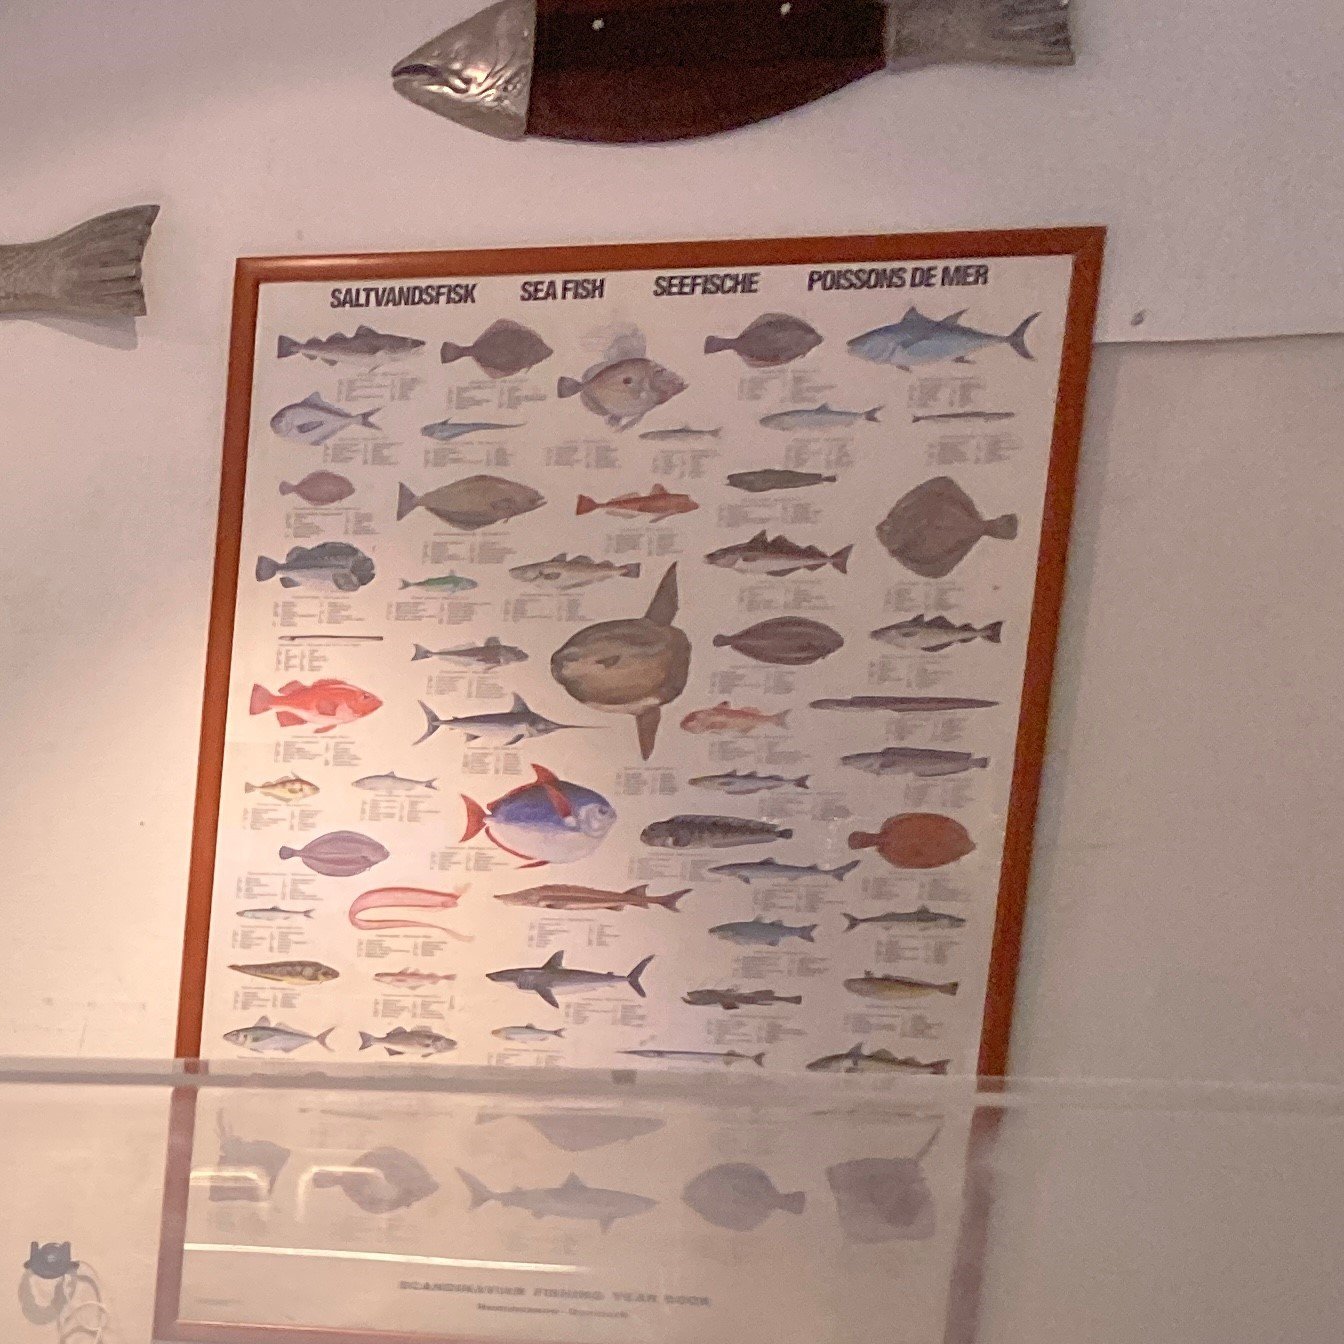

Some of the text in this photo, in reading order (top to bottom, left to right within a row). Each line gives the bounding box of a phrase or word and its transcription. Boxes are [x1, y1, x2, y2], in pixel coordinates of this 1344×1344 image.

[520, 278, 605, 301] SEA FISH
[653, 272, 761, 297] SEEFISCHE
[808, 265, 989, 291] POISSONS DE MER
[330, 283, 478, 308] SALTVANDSFISK
